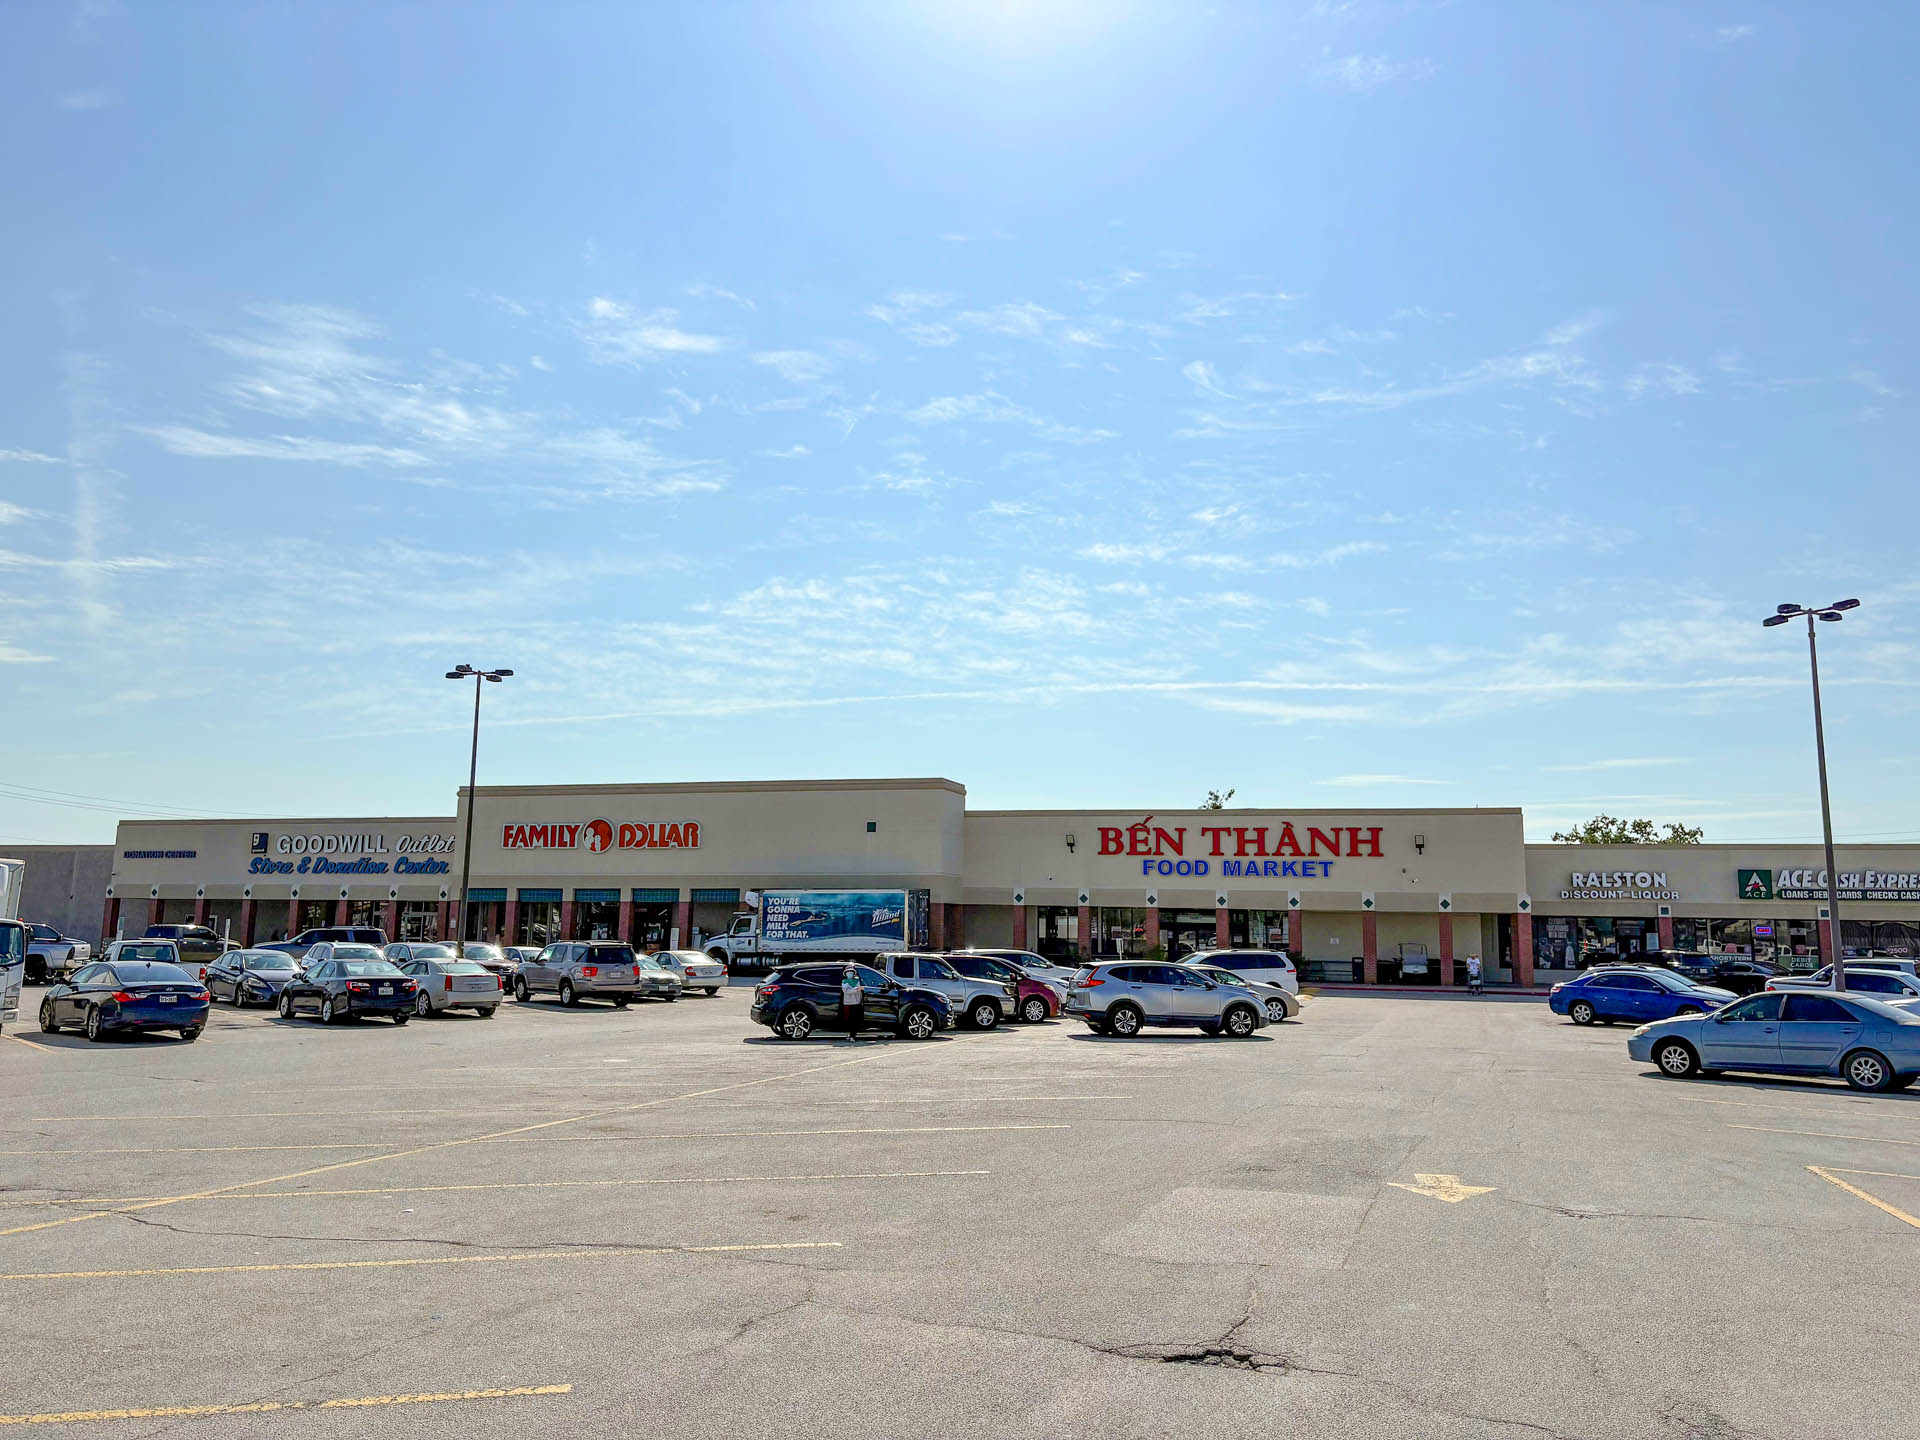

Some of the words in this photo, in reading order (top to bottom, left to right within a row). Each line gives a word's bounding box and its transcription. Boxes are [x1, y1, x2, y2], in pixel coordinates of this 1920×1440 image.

[502, 823, 582, 849] FAMILY
[618, 822, 701, 849] DOLLAR
[1097, 815, 1187, 856] BẾN
[1201, 821, 1384, 857] THÀNH
[276, 834, 389, 854] GOODWILL
[395, 834, 454, 854] Outlet
[248, 856, 294, 874] Store
[296, 856, 312, 874] &
[311, 856, 389, 874] Donation
[393, 857, 449, 874] Center
[1142, 860, 1210, 877] FOOD
[1223, 861, 1334, 878] MARKET
[1571, 871, 1668, 889] RALSTON
[1776, 869, 1813, 888] ACE
[1817, 870, 1860, 889] CSH
[1864, 870, 1920, 889] EXPRE
[768, 897, 800, 905] YOU'RE
[1560, 890, 1624, 900] DISCOUNT
[1631, 890, 1680, 900] LIQUOR
[1836, 891, 1862, 899] CARDS
[1866, 891, 1899, 900] CHECKS
[767, 905, 801, 914] GONNA
[767, 914, 789, 922] NEED
[766, 922, 789, 930] MILK
[766, 930, 784, 939] FOR
[785, 930, 809, 939] THAT.
